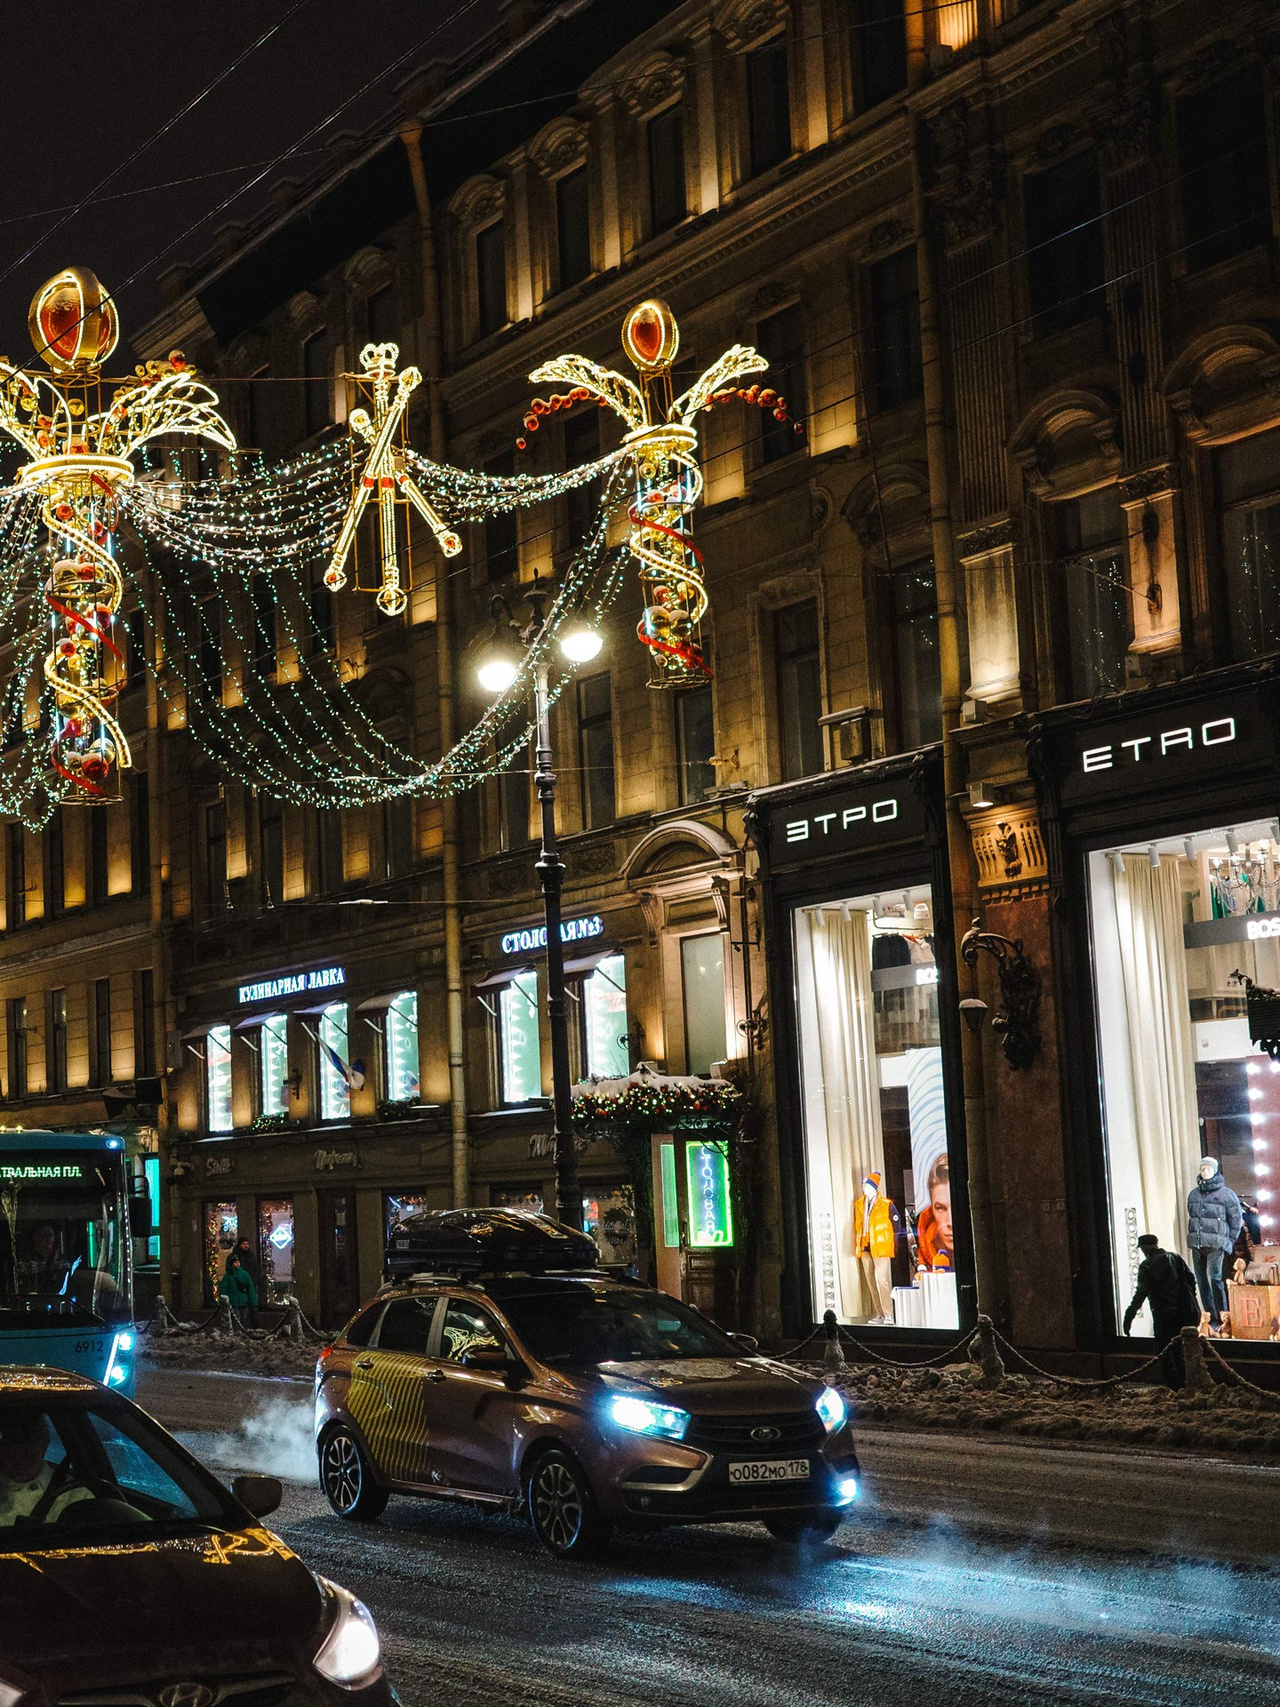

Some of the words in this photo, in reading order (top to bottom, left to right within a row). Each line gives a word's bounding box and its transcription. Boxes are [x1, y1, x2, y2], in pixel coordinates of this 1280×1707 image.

[1082, 717, 1236, 773] ETRO
[786, 798, 898, 843] ЭТРО
[501, 920, 577, 954] СТОЛОАЯ
[238, 974, 306, 1003] КУЛИНАРНАЯ
[307, 967, 345, 990] ЛАВКА
[62, 1166, 82, 1178] ПЛ.
[700, 1145, 716, 1236] СТОЛОВАЯ
[74, 1340, 105, 1354] 6912
